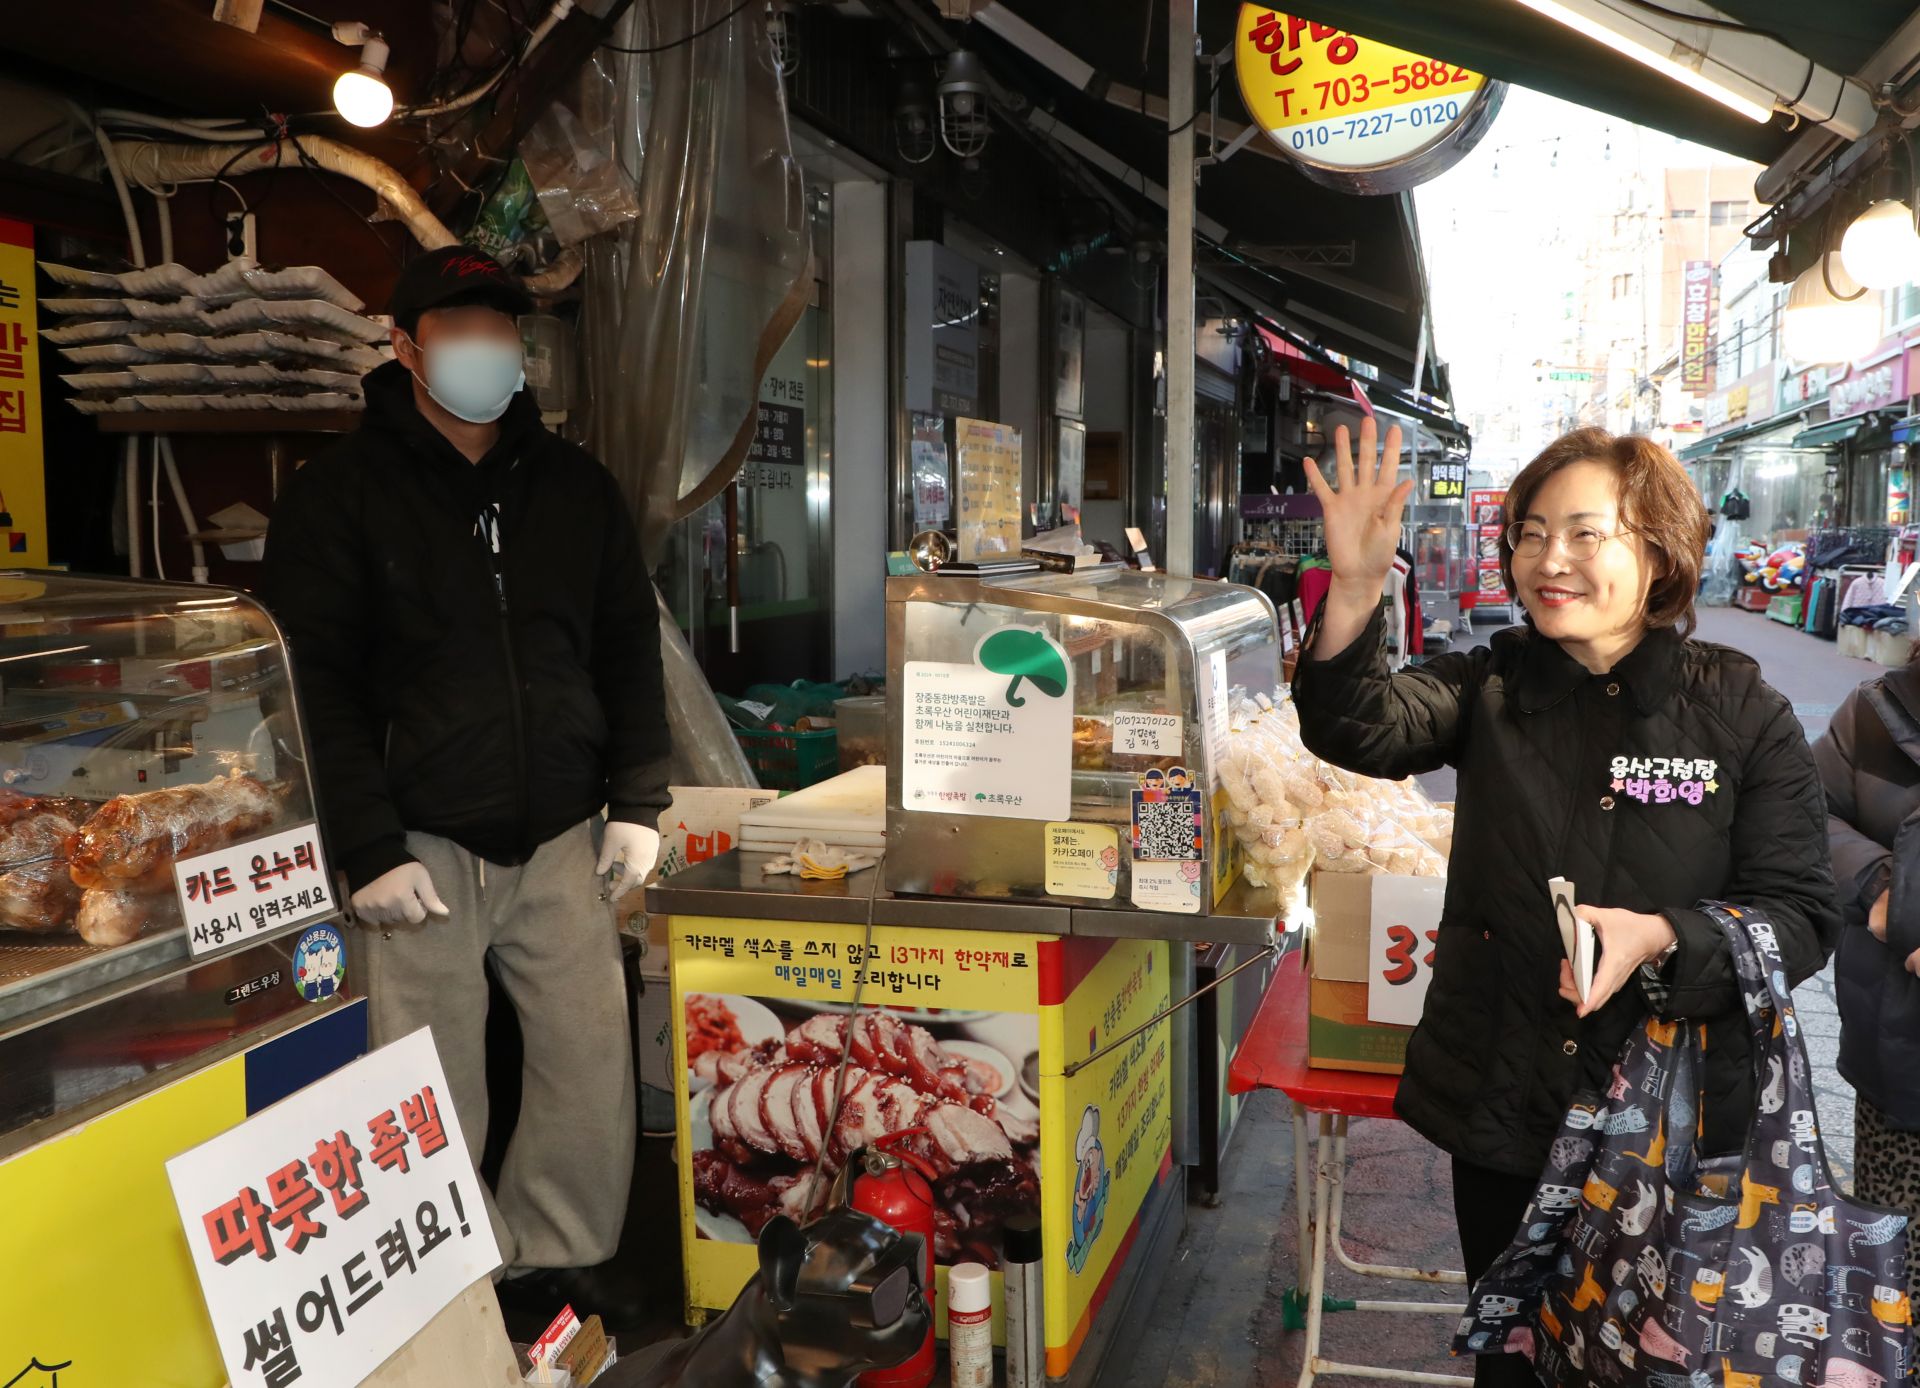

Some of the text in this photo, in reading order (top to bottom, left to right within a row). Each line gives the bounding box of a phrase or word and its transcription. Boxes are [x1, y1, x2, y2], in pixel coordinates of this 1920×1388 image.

[1292, 101, 1459, 150] 010-7227-0120
[1433, 481, 1462, 496] 출시
[914, 705, 1010, 721] 초록우산 어린이재단과
[914, 719, 934, 731] 함께
[966, 722, 1015, 735] 실천합니다.
[1610, 756, 1718, 780] 용산구청장
[987, 793, 1022, 806] 초록우산
[1625, 778, 1704, 805] 박희영
[1052, 847, 1095, 859] 카카오페이
[186, 841, 317, 904] 카드 온누리
[193, 886, 327, 944] 사용시 알려주세요
[685, 934, 735, 958] 카라멜
[743, 936, 794, 958] 색소를
[803, 940, 837, 959] 쓰지
[954, 948, 1029, 973] 한약재로
[775, 965, 842, 990] 매일매일
[202, 1085, 449, 1266] 따뜻한 족발
